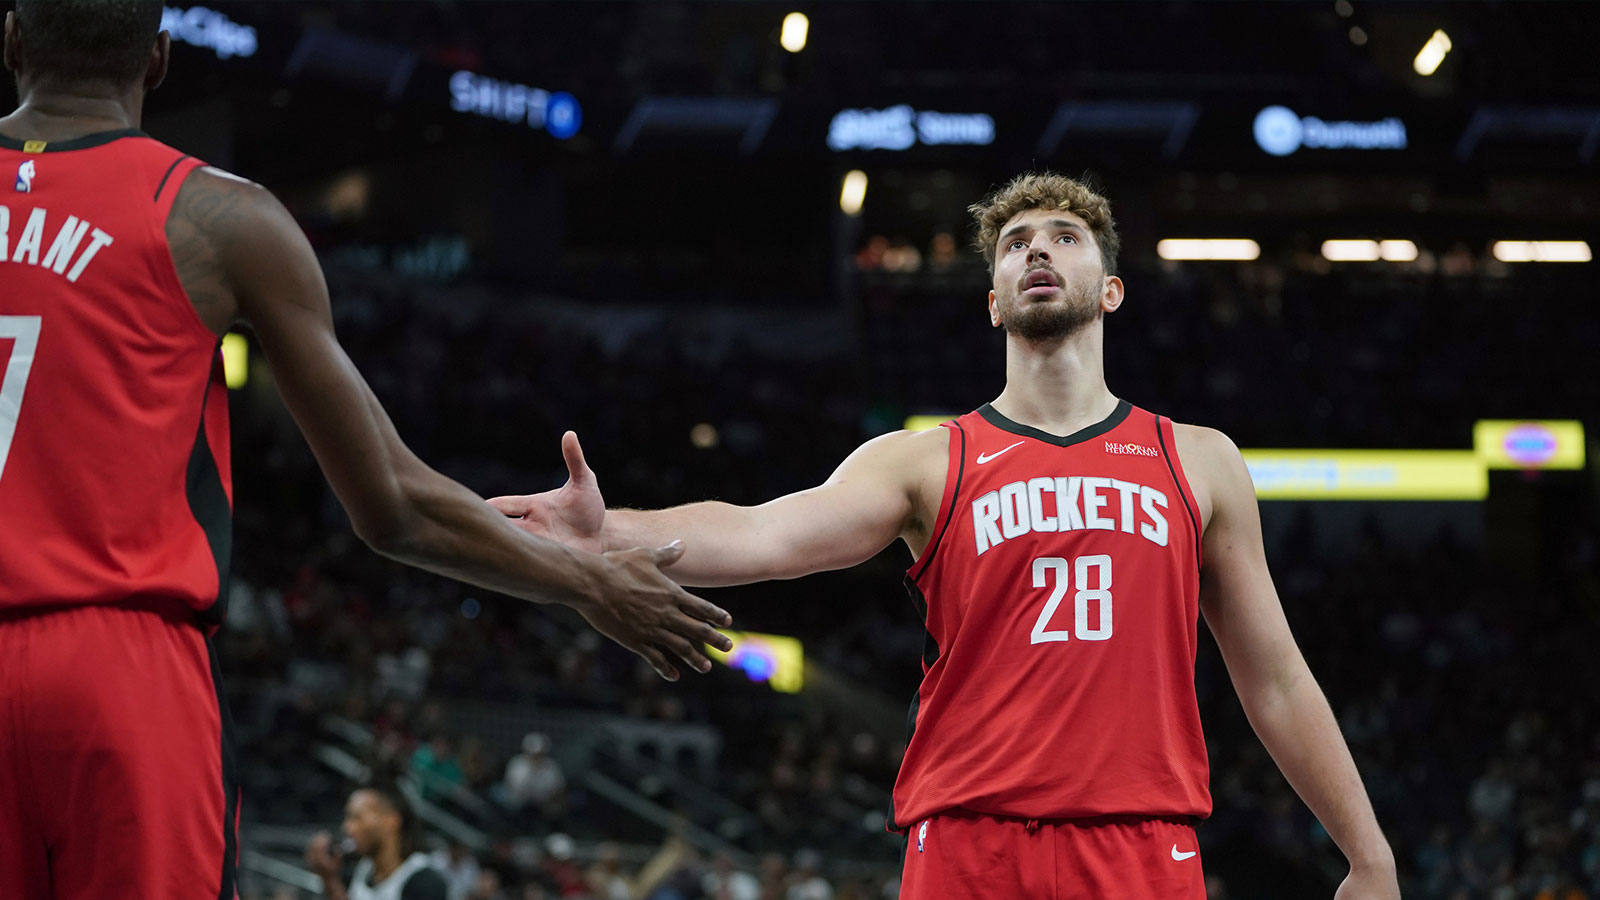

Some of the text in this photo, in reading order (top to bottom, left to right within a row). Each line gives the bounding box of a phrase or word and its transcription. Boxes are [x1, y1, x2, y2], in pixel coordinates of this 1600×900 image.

[0, 315, 42, 482] 7
[1105, 441, 1156, 452] MEMORIAL
[972, 477, 1168, 556] ROCKETS
[1031, 554, 1113, 645] 28
